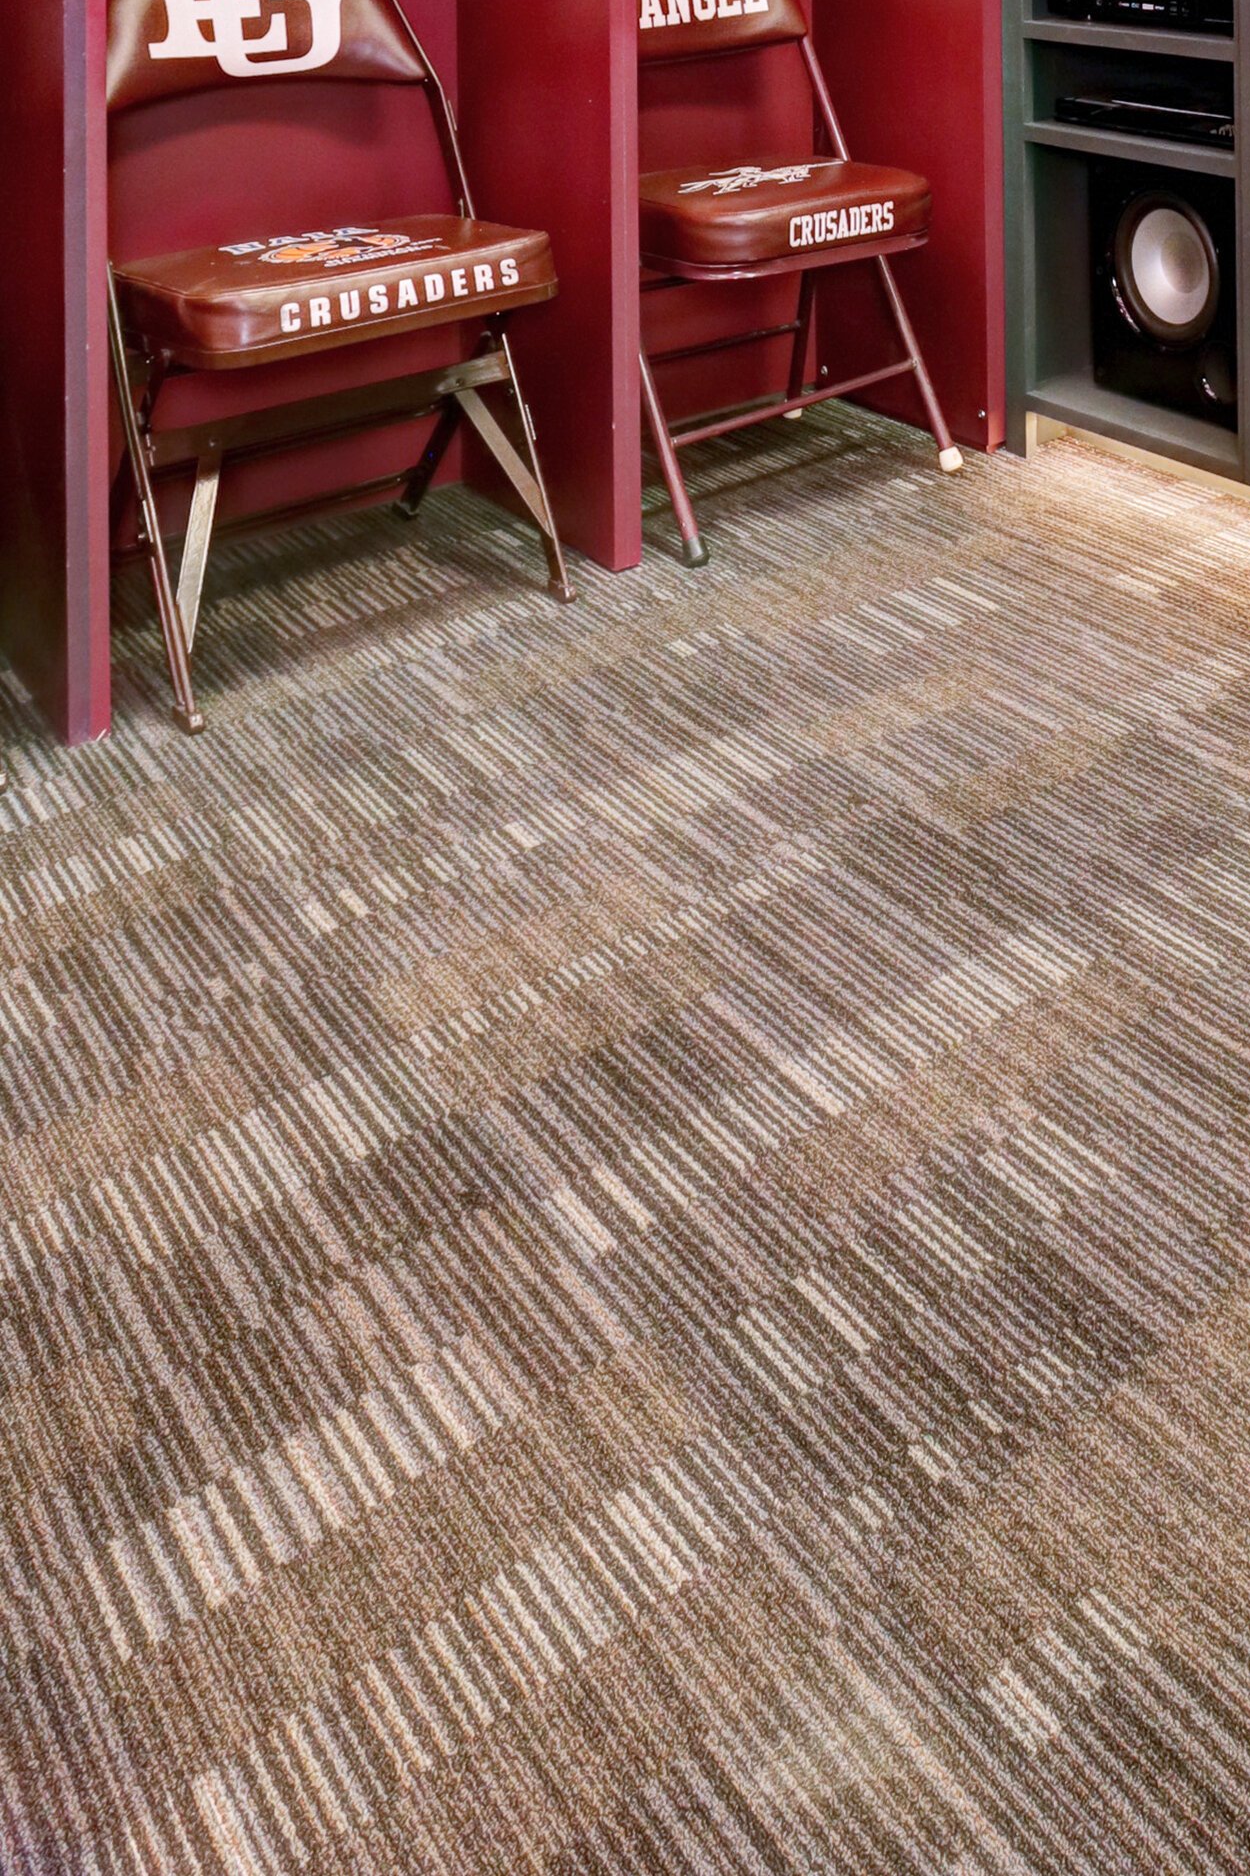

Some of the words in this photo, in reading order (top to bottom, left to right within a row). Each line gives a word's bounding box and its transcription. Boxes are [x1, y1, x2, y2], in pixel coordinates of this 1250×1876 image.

[218, 226, 380, 256] NAIA
[789, 201, 894, 249] CRUSADERS
[280, 258, 520, 333] CRUSADERS
